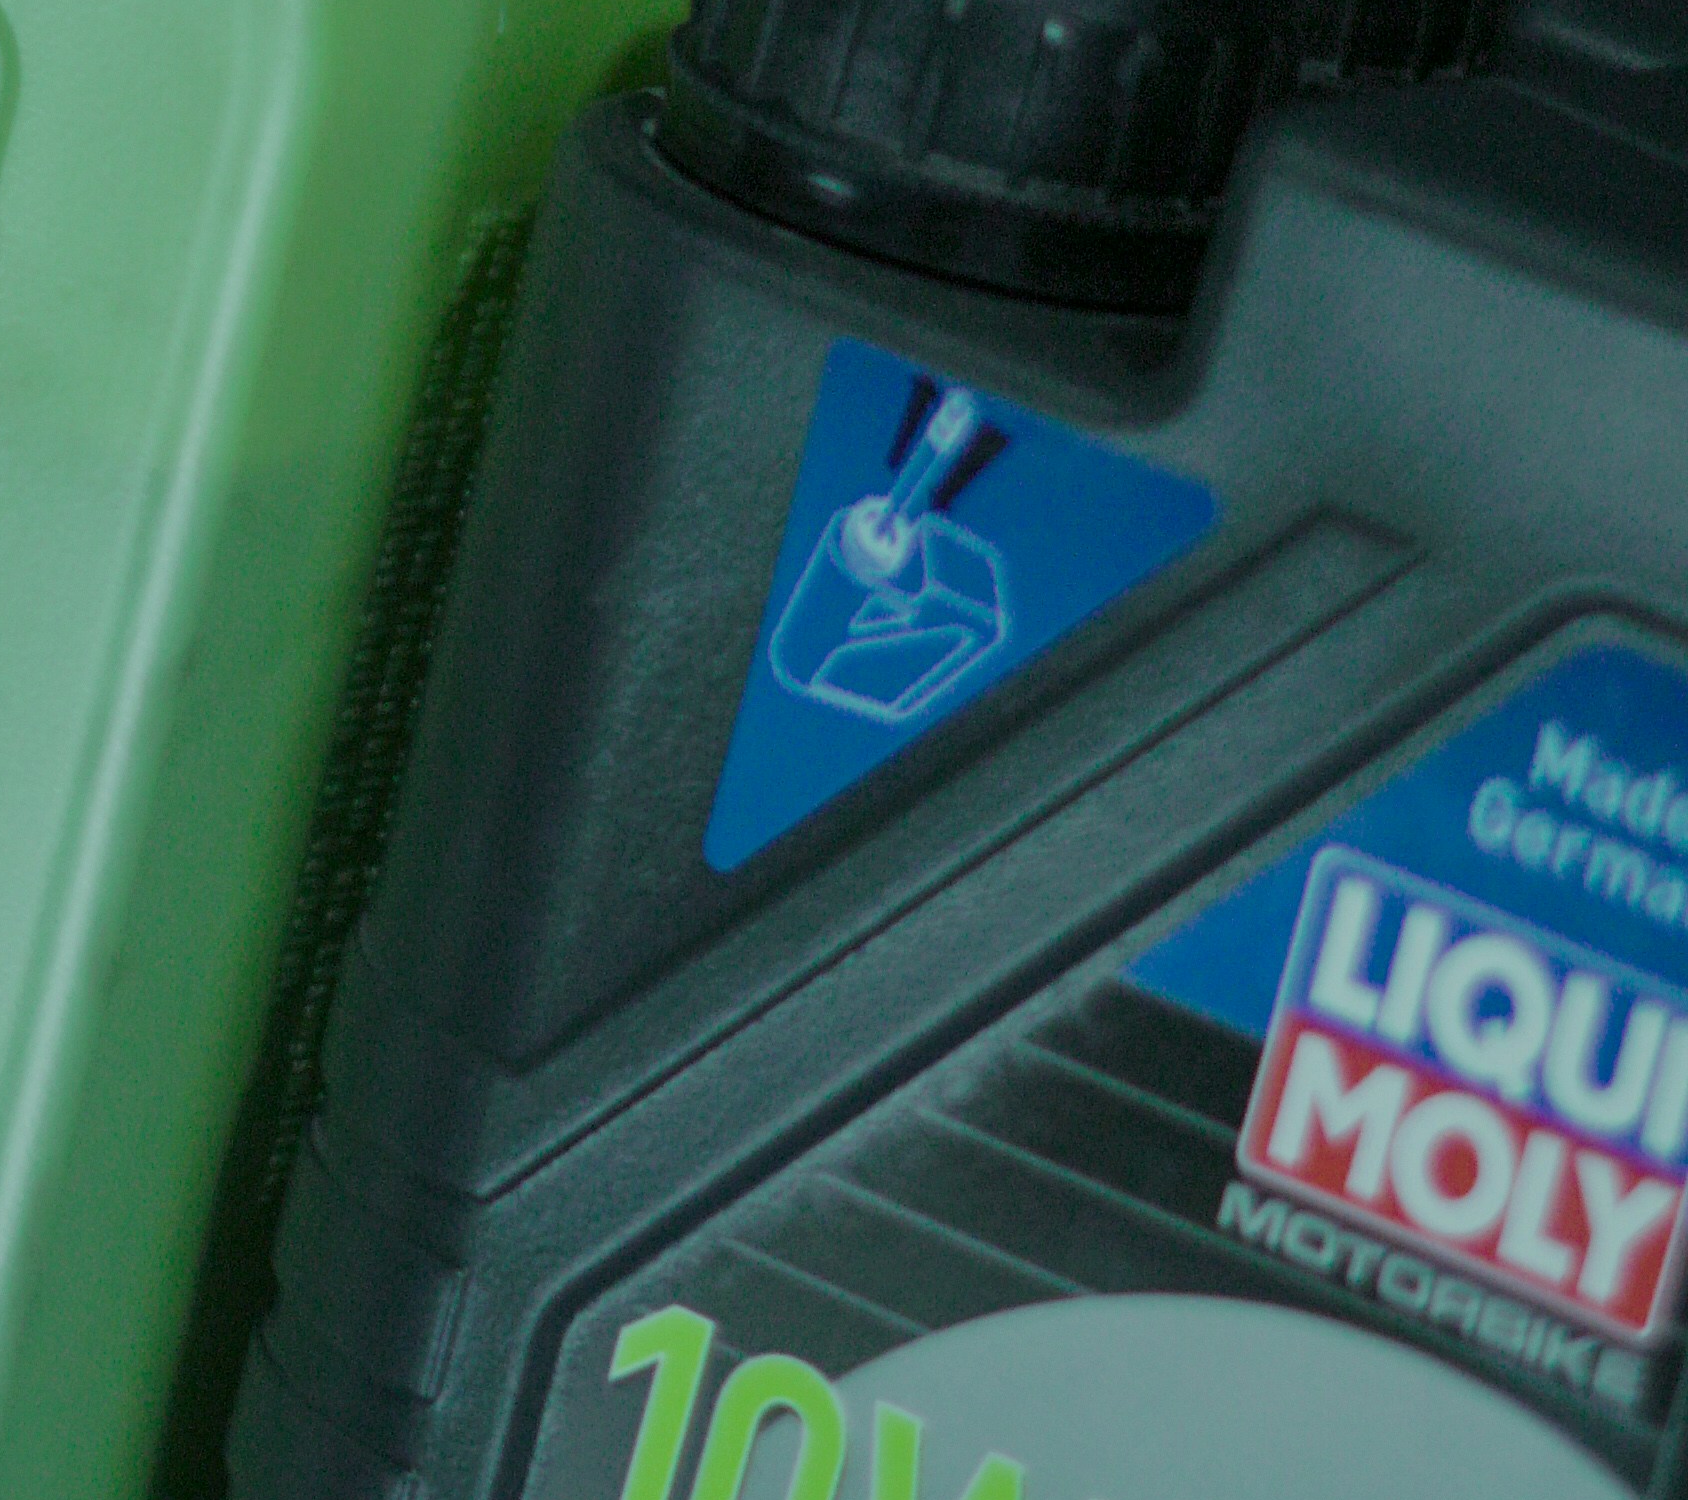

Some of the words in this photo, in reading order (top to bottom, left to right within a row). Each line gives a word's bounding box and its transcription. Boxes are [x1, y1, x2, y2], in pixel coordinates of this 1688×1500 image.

[1469, 776, 1688, 926] Germa
[1266, 1031, 1675, 1301] MOLY
[1217, 1181, 1648, 1408] MOTORBIKE
